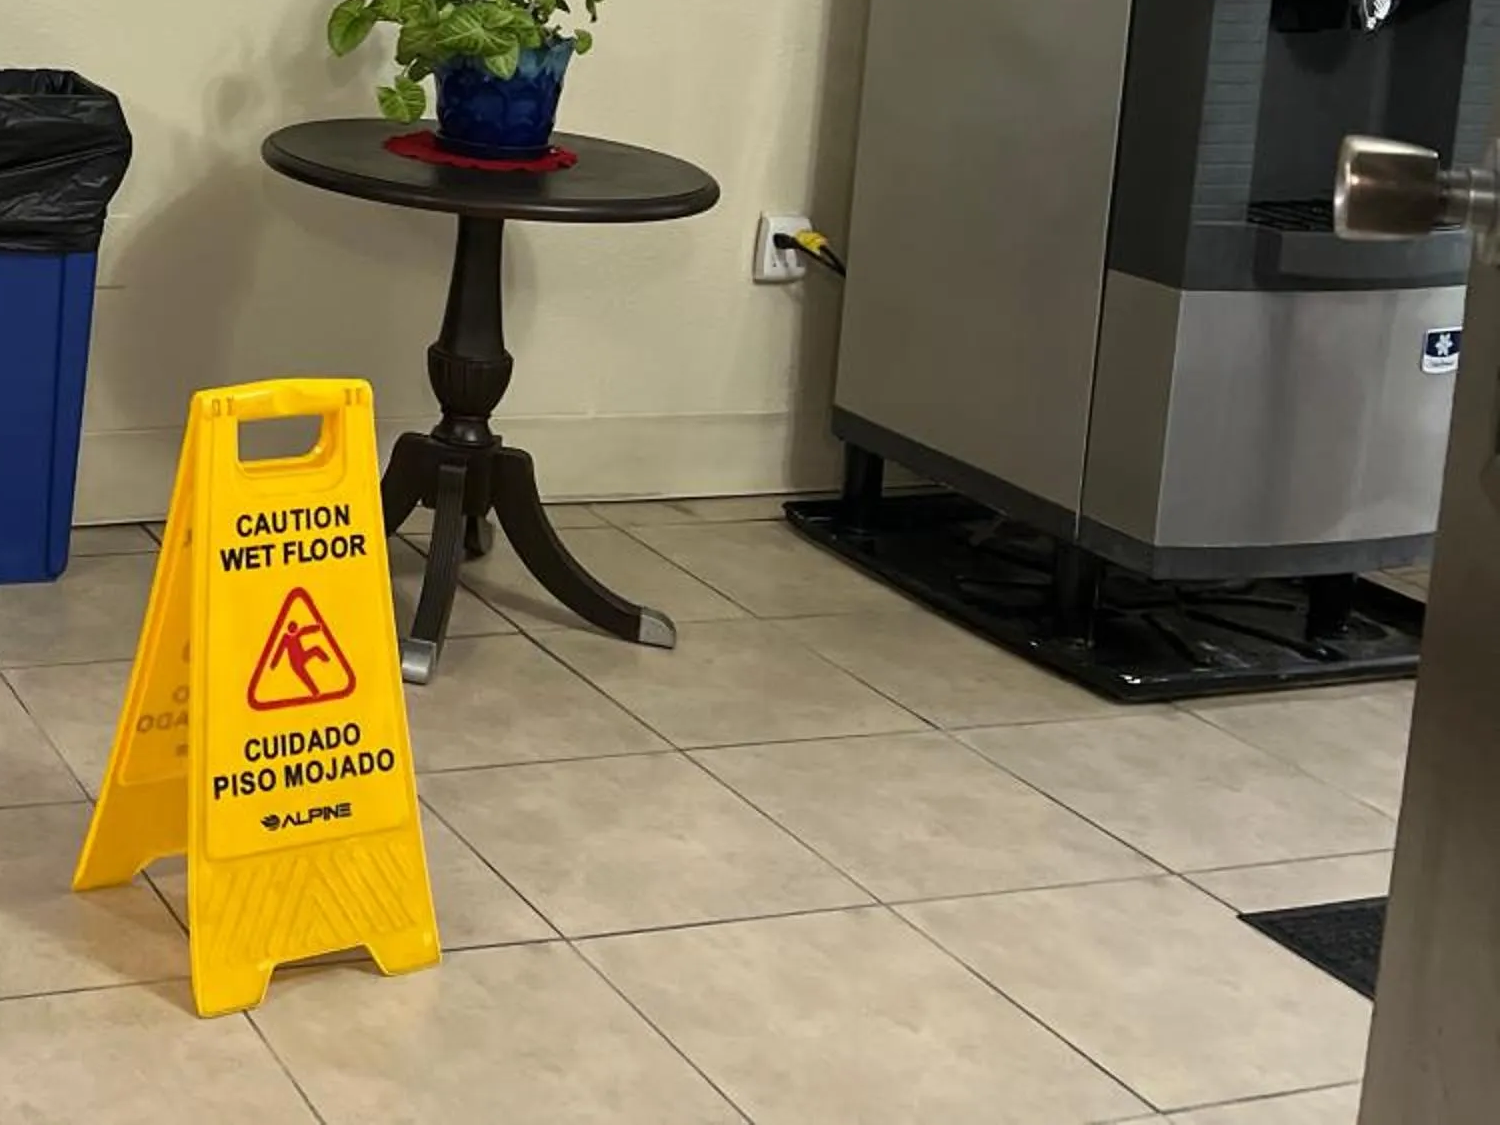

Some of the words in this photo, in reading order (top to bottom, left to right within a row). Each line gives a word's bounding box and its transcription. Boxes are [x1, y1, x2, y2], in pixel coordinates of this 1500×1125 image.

[236, 504, 350, 537] CAUTION
[220, 544, 275, 572] WET
[283, 534, 366, 565] FLOOR
[244, 723, 360, 762] CUIDADO
[213, 768, 277, 800] PISO
[284, 748, 394, 788] MOJADO
[281, 802, 353, 828] ALPINE
